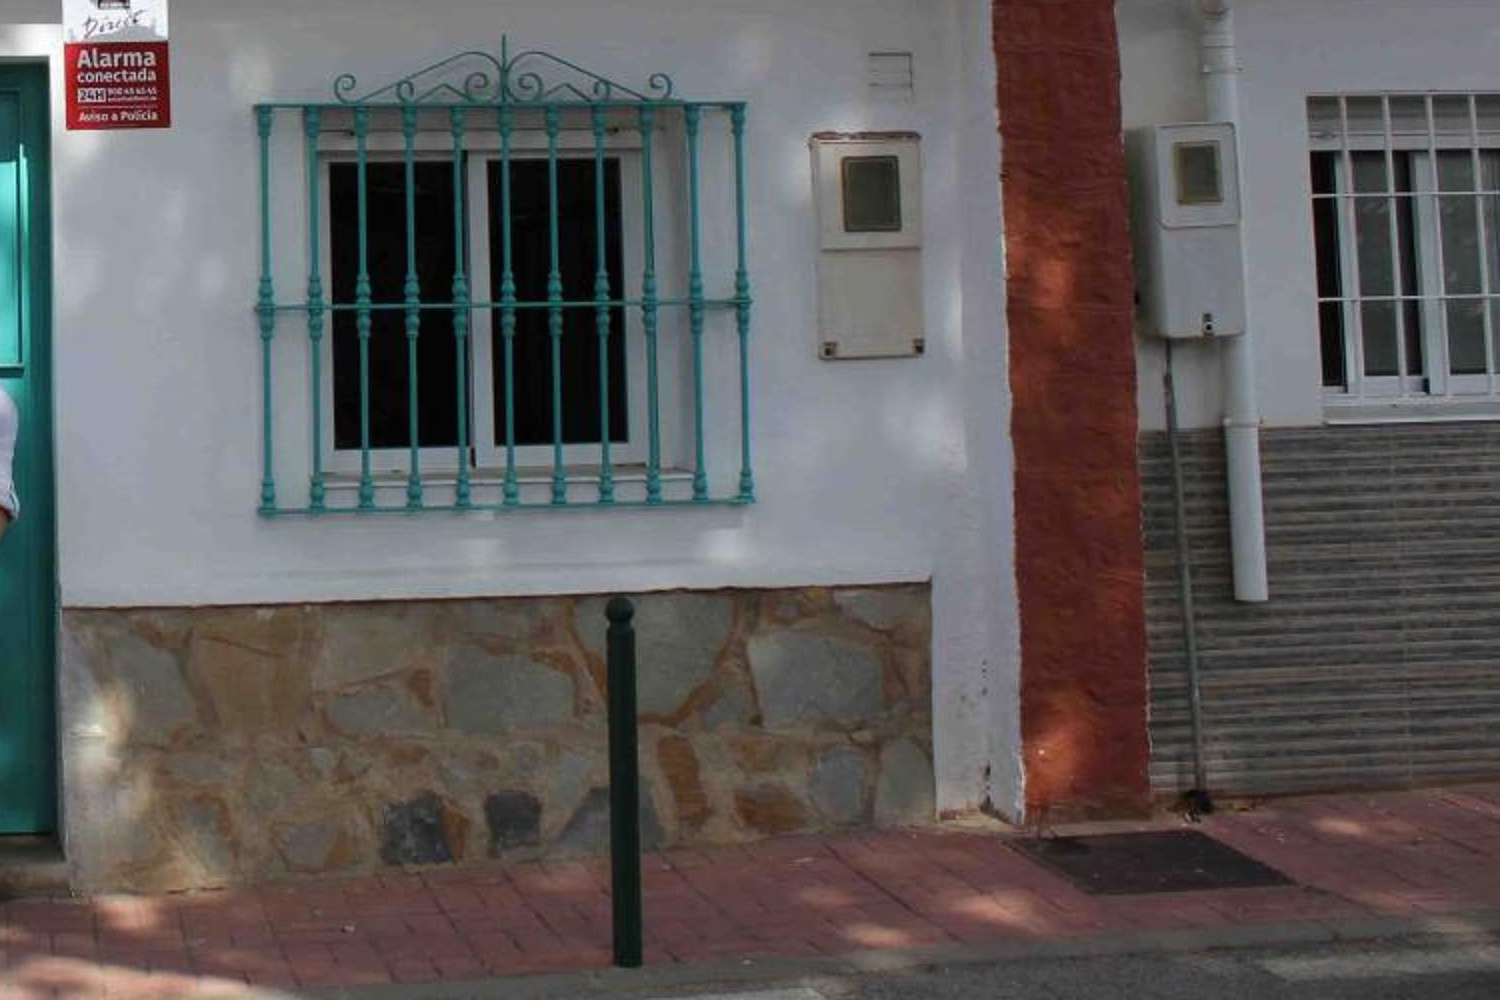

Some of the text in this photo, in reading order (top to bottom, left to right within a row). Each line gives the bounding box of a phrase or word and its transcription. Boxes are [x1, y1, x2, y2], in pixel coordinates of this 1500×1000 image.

[78, 48, 156, 68] Alarma
[78, 68, 156, 83] conectada
[80, 88, 106, 101] 24H
[79, 111, 109, 122] Aviso
